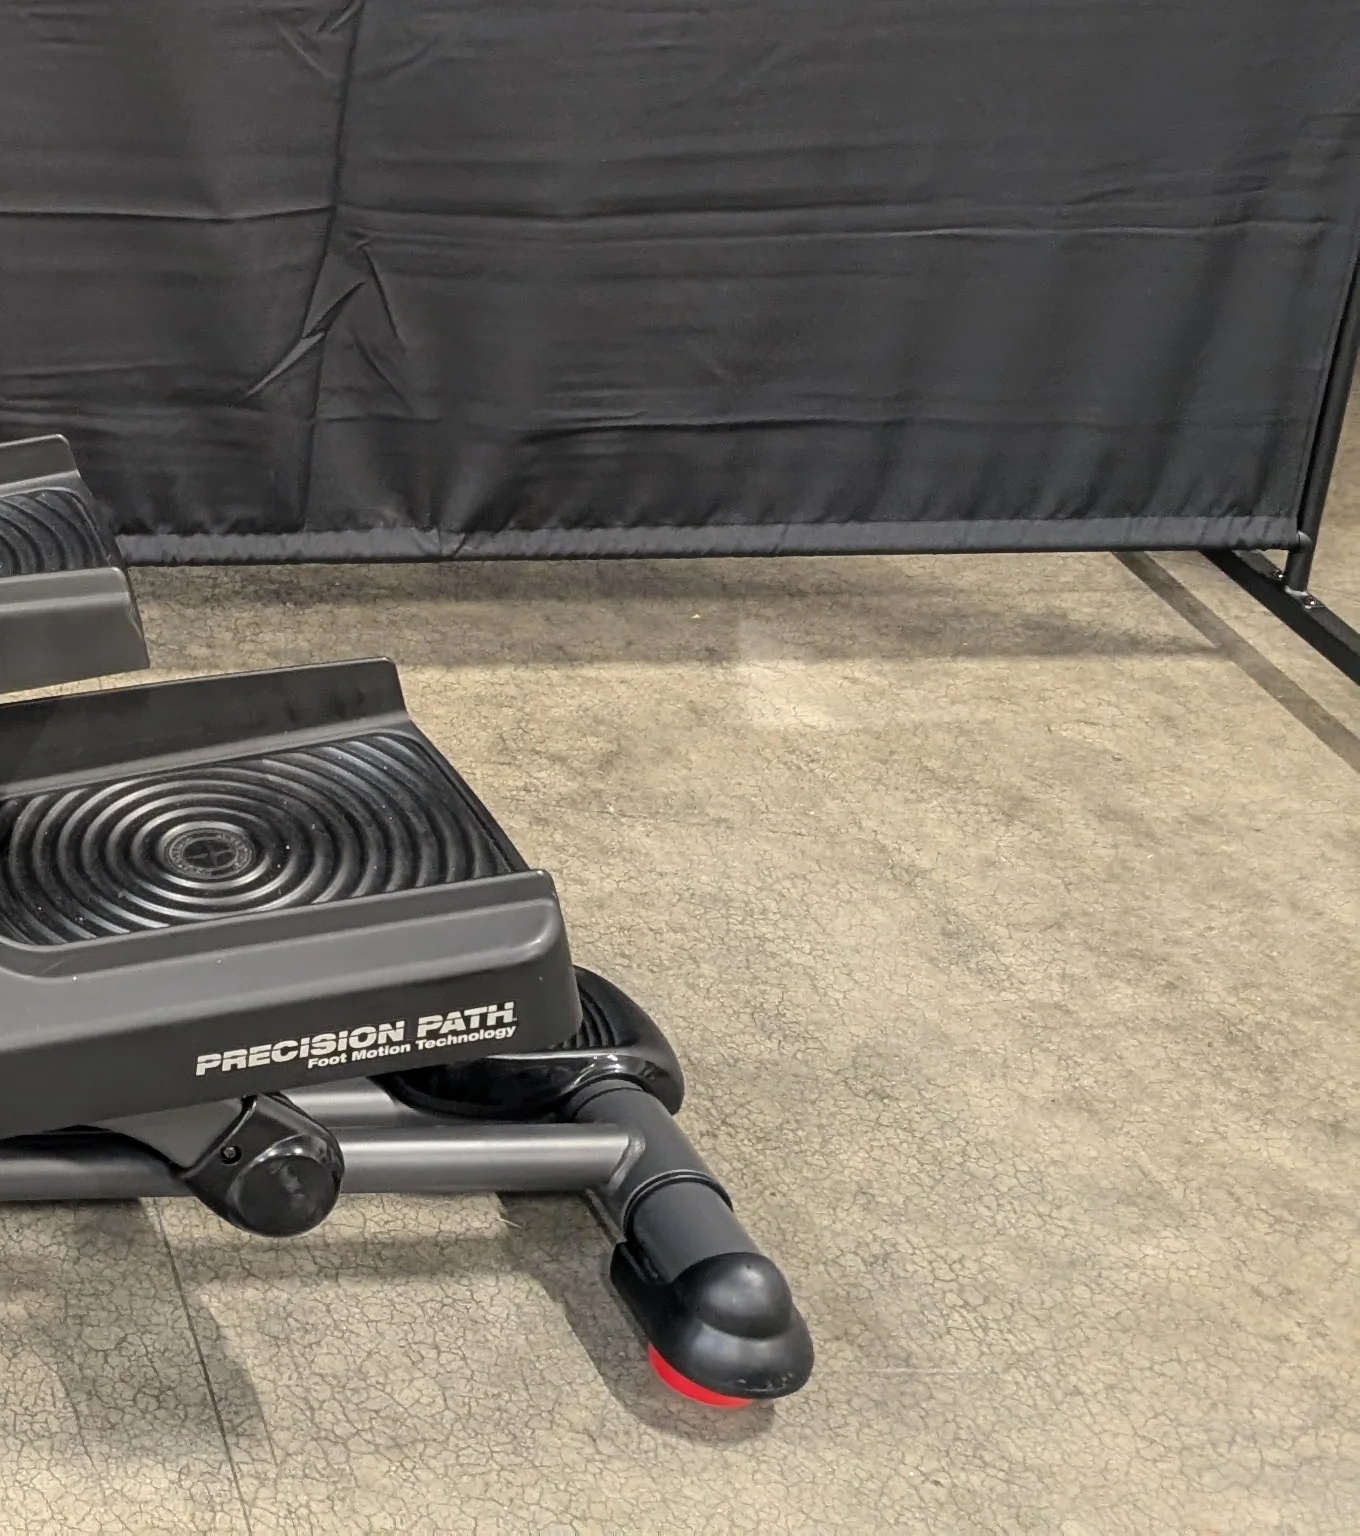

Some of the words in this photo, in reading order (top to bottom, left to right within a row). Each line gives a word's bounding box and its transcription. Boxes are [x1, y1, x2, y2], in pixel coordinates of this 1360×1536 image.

[195, 1020, 405, 1076] PRECISION
[416, 1001, 516, 1038] PATH
[307, 1054, 347, 1069] Foot
[351, 1043, 411, 1062] Motion
[415, 1024, 517, 1051] Technology
